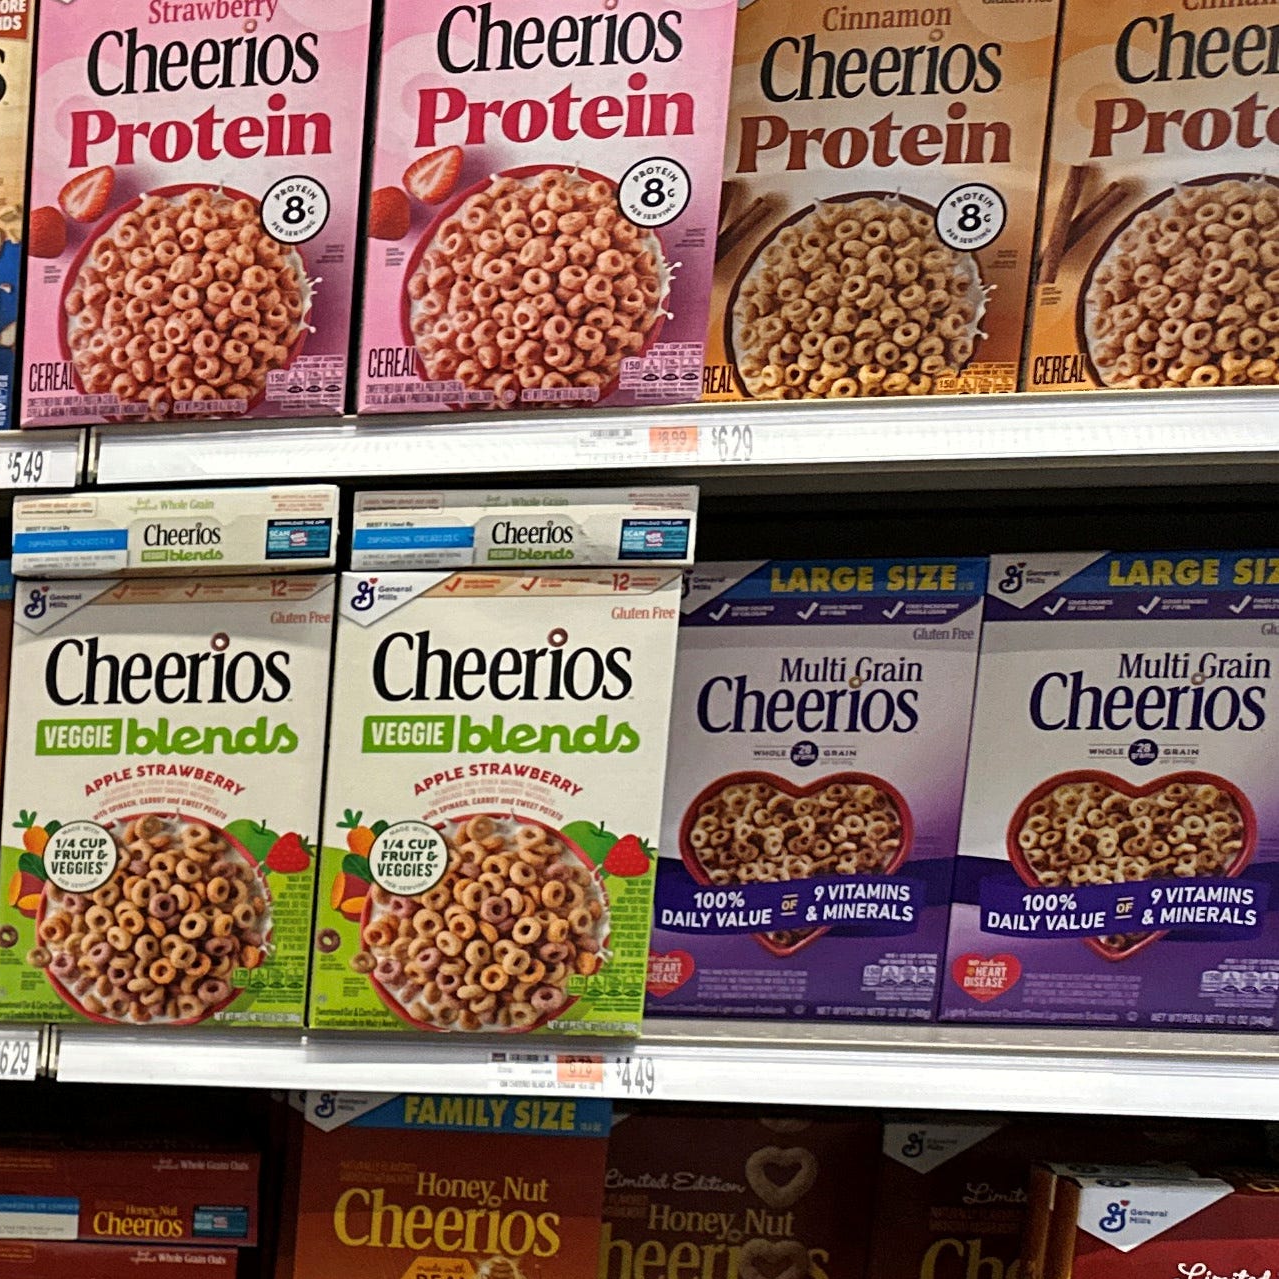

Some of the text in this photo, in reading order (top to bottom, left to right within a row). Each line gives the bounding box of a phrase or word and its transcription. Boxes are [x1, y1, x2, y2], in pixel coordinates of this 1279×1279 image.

[822, 6, 952, 32] Cinnamon
[86, 18, 320, 96] Cheerios
[414, 72, 694, 148] Protein
[69, 93, 332, 168] Protein
[735, 102, 1012, 174] Protein
[368, 345, 417, 379] CEREAL
[1033, 354, 1087, 385] CEREAL
[270, 580, 287, 596] 12
[770, 565, 957, 593] LARGE SIZE
[611, 607, 675, 620] Gluten Free
[373, 628, 632, 702] Cheerios
[780, 657, 923, 682] Multi Grain
[1119, 653, 1271, 679] Multi Grain
[45, 716, 299, 755] VEGGIE blends
[84, 764, 246, 797] APPLE STRAWBERRY
[54, 850, 108, 860] FRUIT &
[55, 839, 107, 849] 1/4 CUP
[693, 891, 745, 908] 100%
[814, 884, 910, 901] 9 VITAMINS
[1022, 894, 1077, 911] 100%
[661, 909, 772, 927] DAILY VALUE
[987, 911, 1106, 930] DAILY VALUE
[963, 976, 1005, 988] DISEASE
[975, 966, 1007, 978] HEART
[417, 1171, 549, 1202] Honey Nut
[605, 1169, 745, 1193] Limited Edition
[334, 1188, 560, 1257] Cheerios
